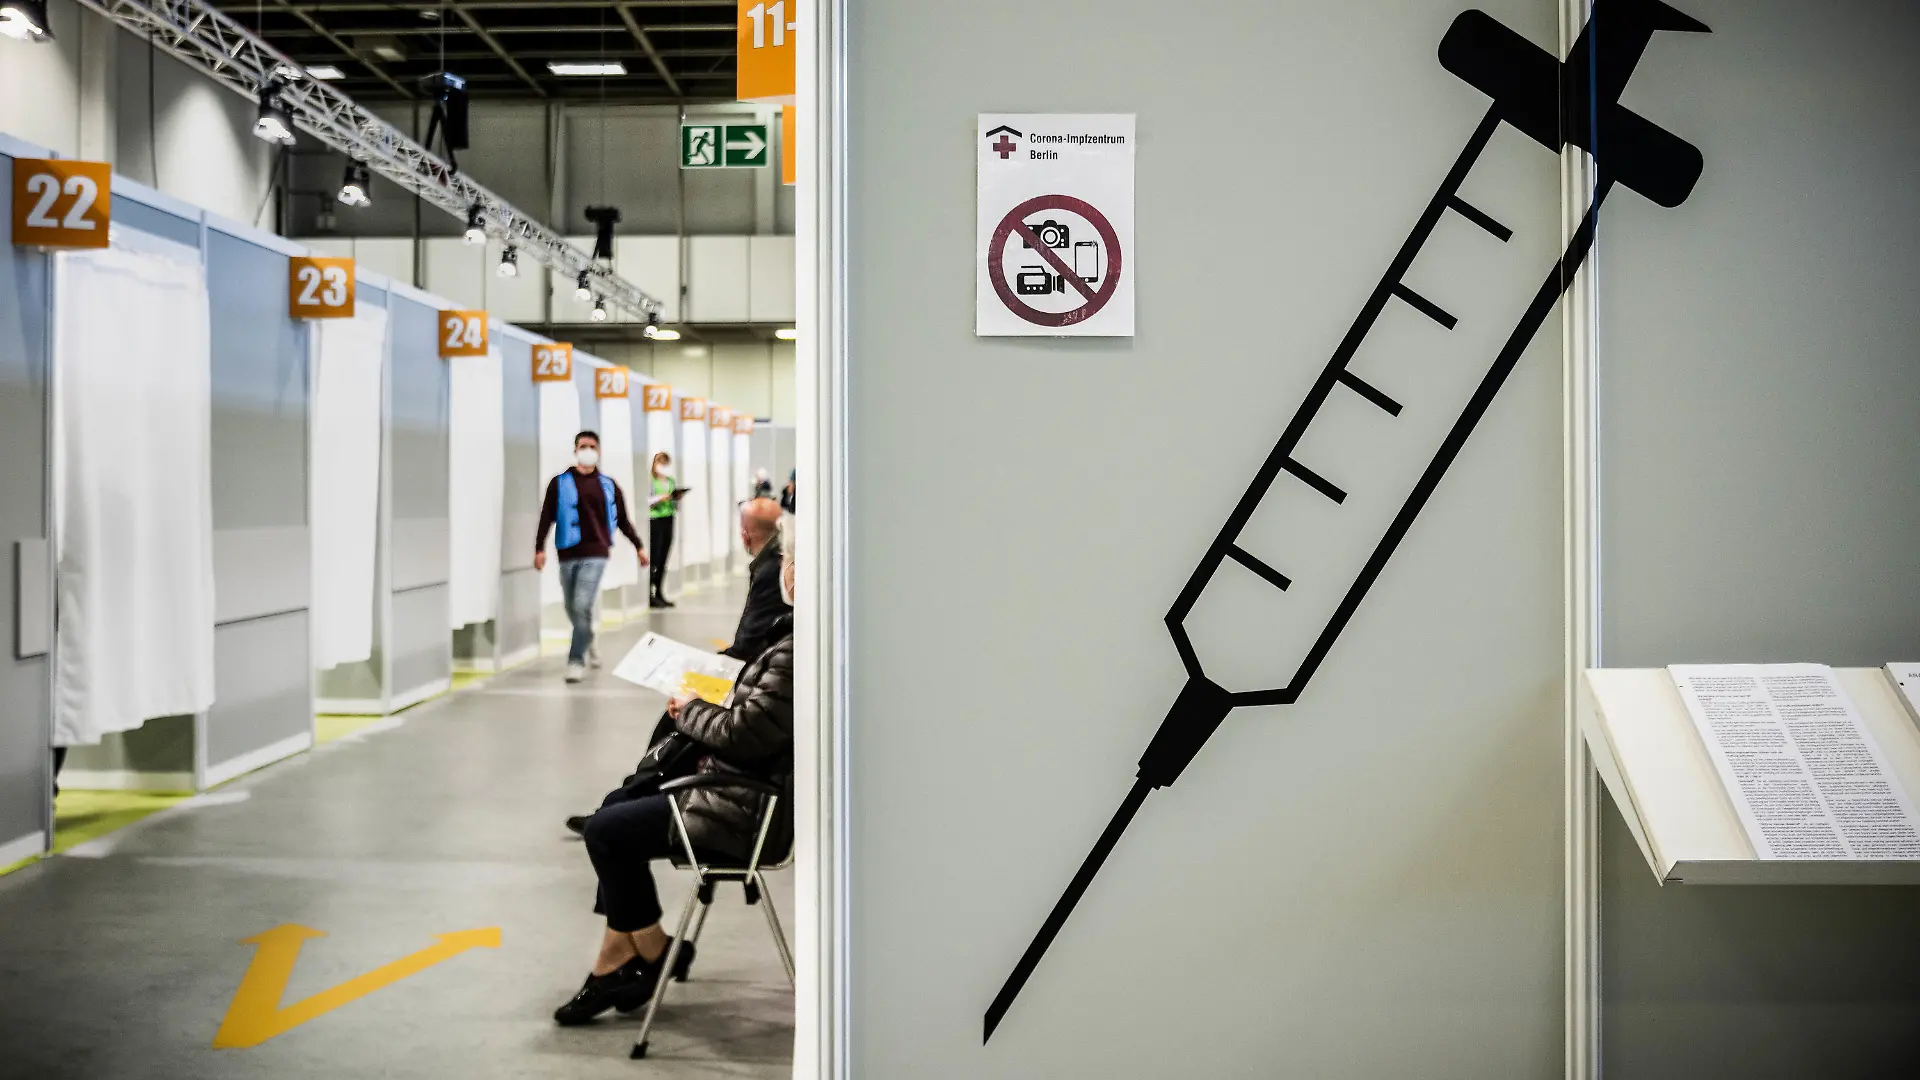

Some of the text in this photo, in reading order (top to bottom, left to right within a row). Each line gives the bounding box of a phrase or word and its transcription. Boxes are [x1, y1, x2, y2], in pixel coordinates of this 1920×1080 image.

[1029, 132, 1125, 146] Corona-Impfzentrum
[1029, 149, 1058, 160] Berlin
[27, 172, 98, 230] 22
[297, 265, 347, 307] 23
[445, 316, 482, 349] 24
[536, 349, 568, 376] 25
[648, 388, 669, 408] 27
